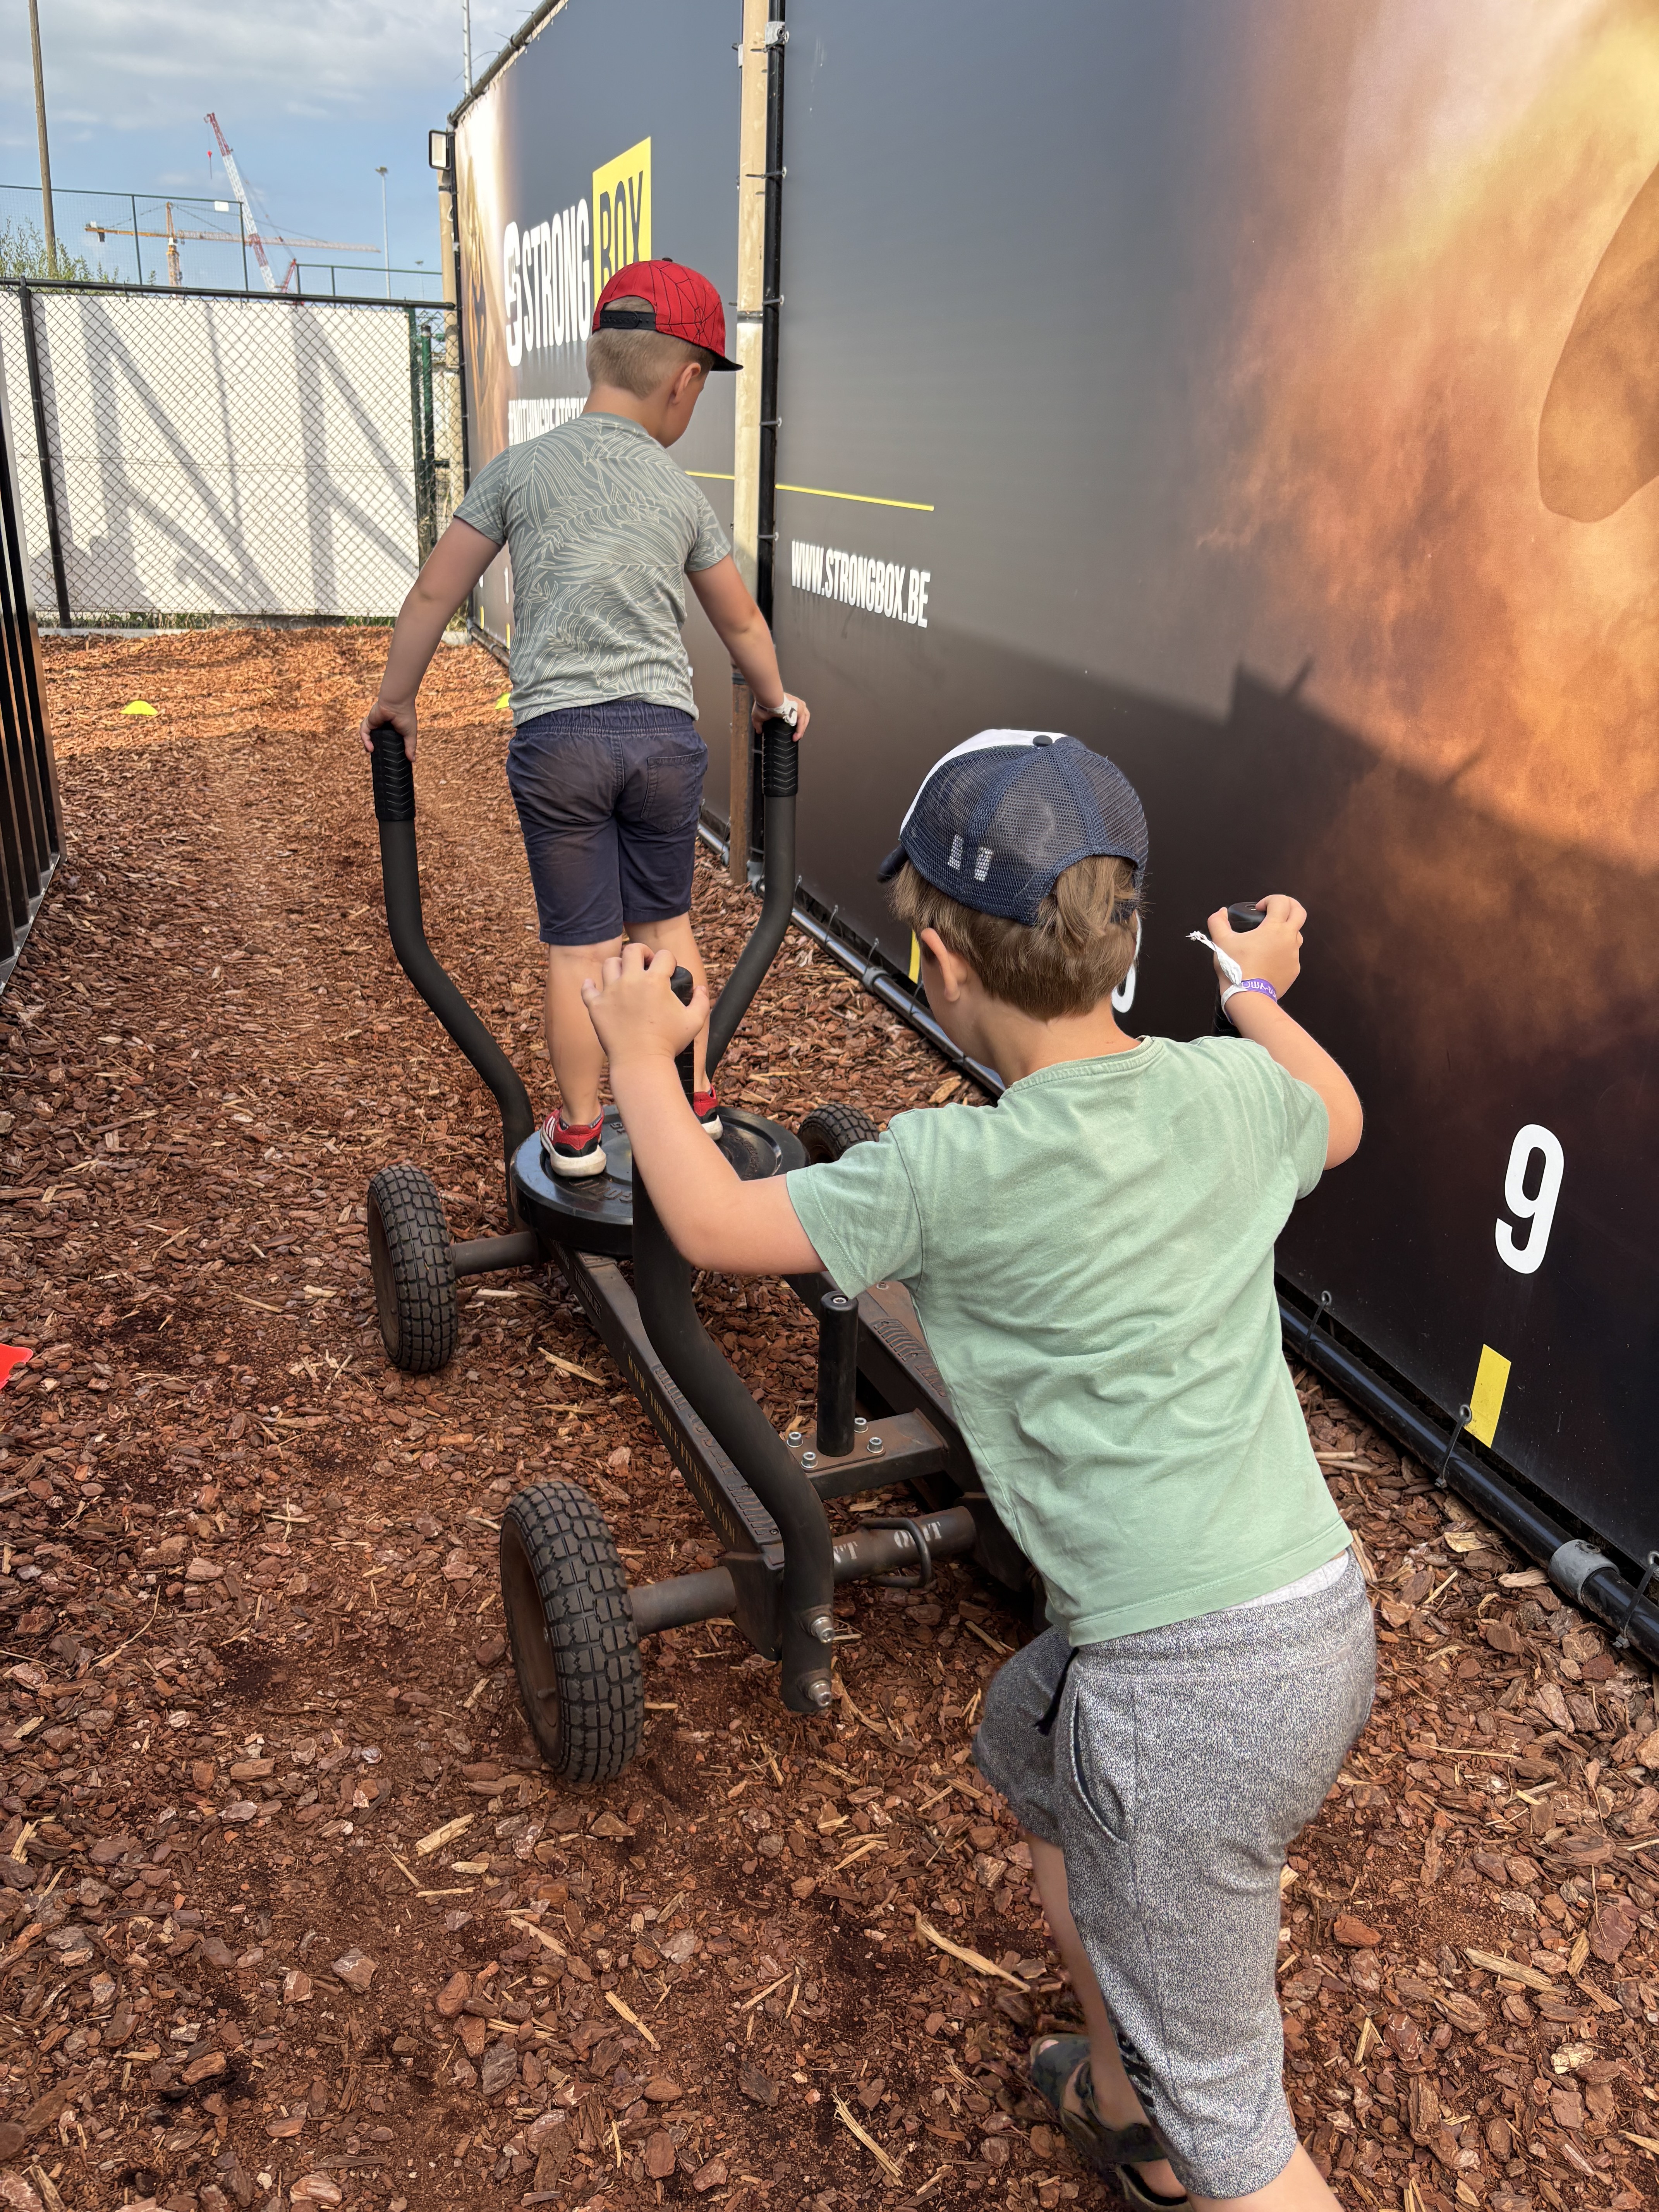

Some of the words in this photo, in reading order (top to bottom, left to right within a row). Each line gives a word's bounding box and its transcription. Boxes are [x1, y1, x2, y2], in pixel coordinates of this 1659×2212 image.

[522, 198, 591, 352] STRONG
[792, 540, 931, 628] WWW.STRONGBOX.BE
[1495, 1124, 1564, 1274] 9
